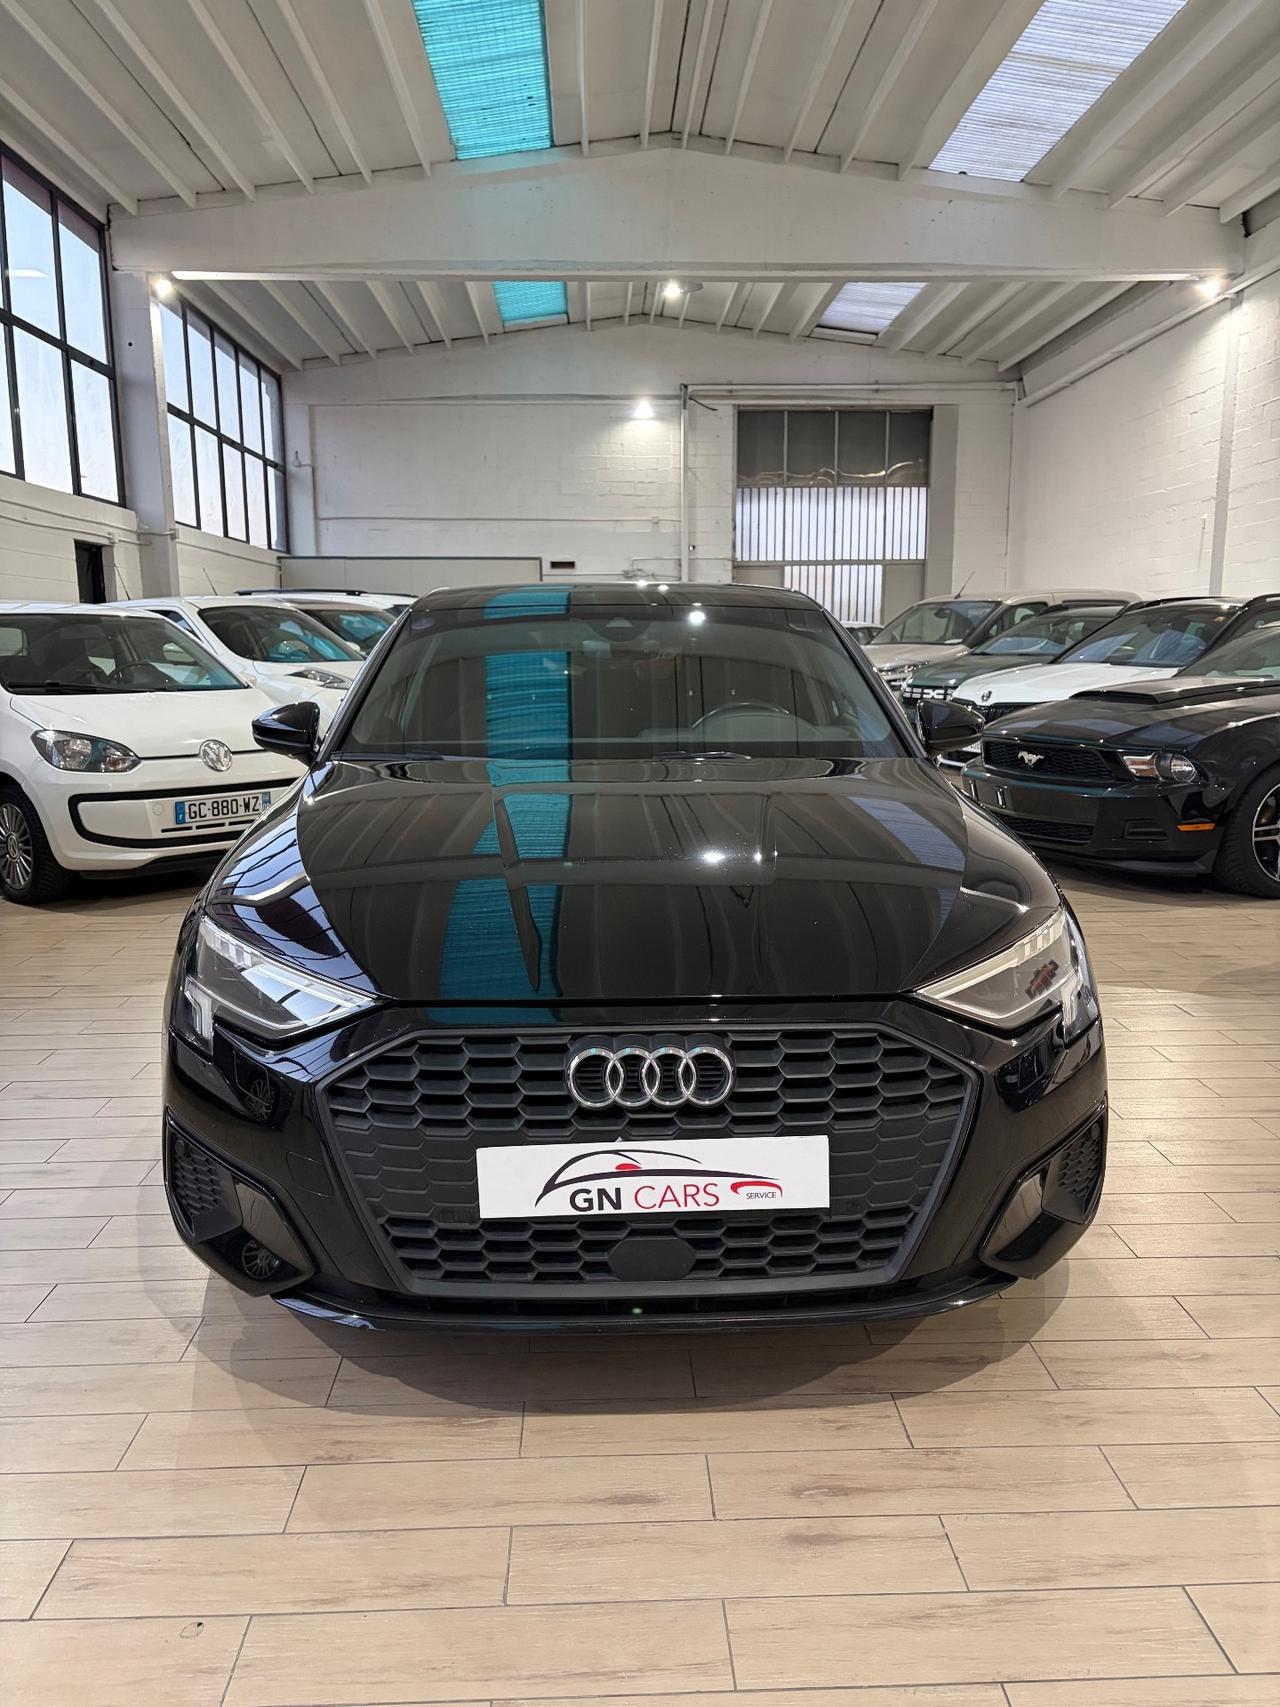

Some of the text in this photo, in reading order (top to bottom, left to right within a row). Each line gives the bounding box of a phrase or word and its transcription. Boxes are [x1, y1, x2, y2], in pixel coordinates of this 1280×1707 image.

[569, 1182, 720, 1212] GN CARS
[745, 1191, 777, 1201] SERVICE
